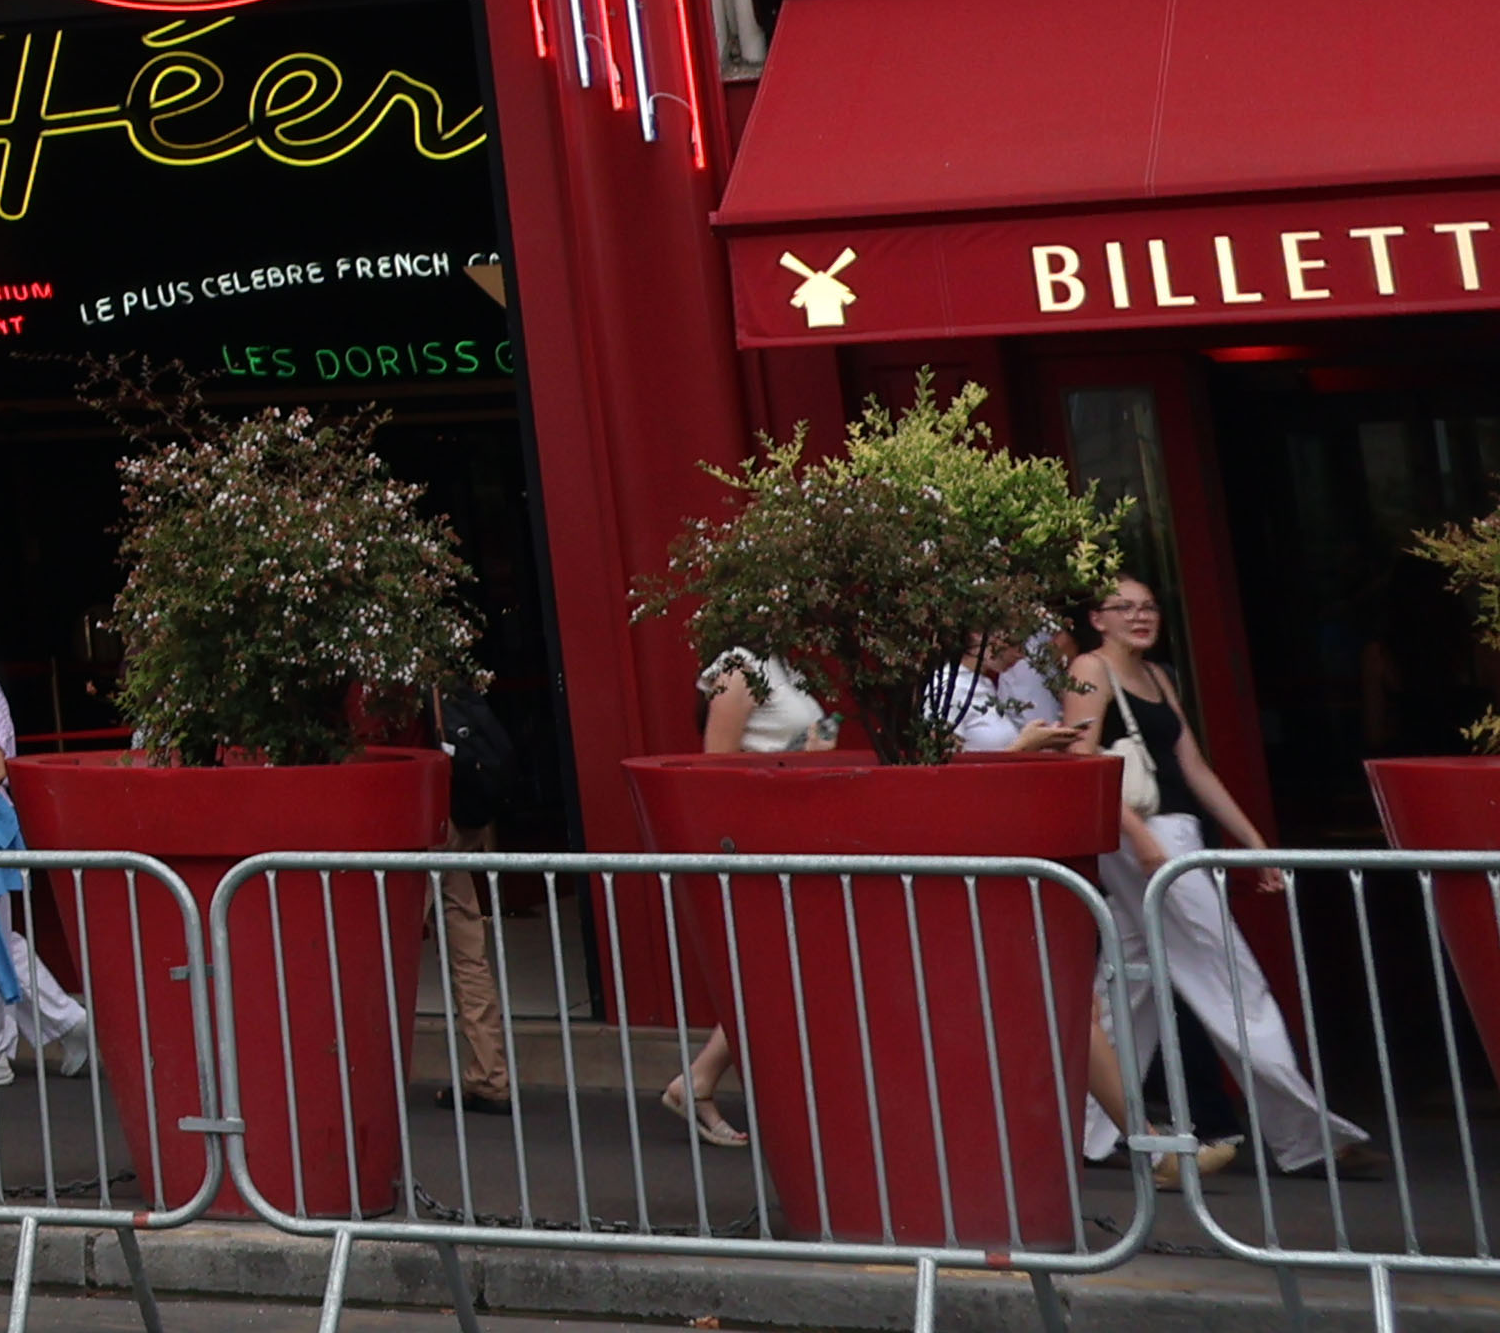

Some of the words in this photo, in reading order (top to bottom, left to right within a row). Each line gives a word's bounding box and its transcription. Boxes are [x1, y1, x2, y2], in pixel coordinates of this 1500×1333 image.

[80, 295, 113, 325] LE
[122, 280, 194, 315] PLUS
[201, 261, 325, 300] CELEBRE
[337, 252, 450, 284] FRENCH
[221, 341, 296, 376] LES
[317, 339, 479, 380] DORISS
